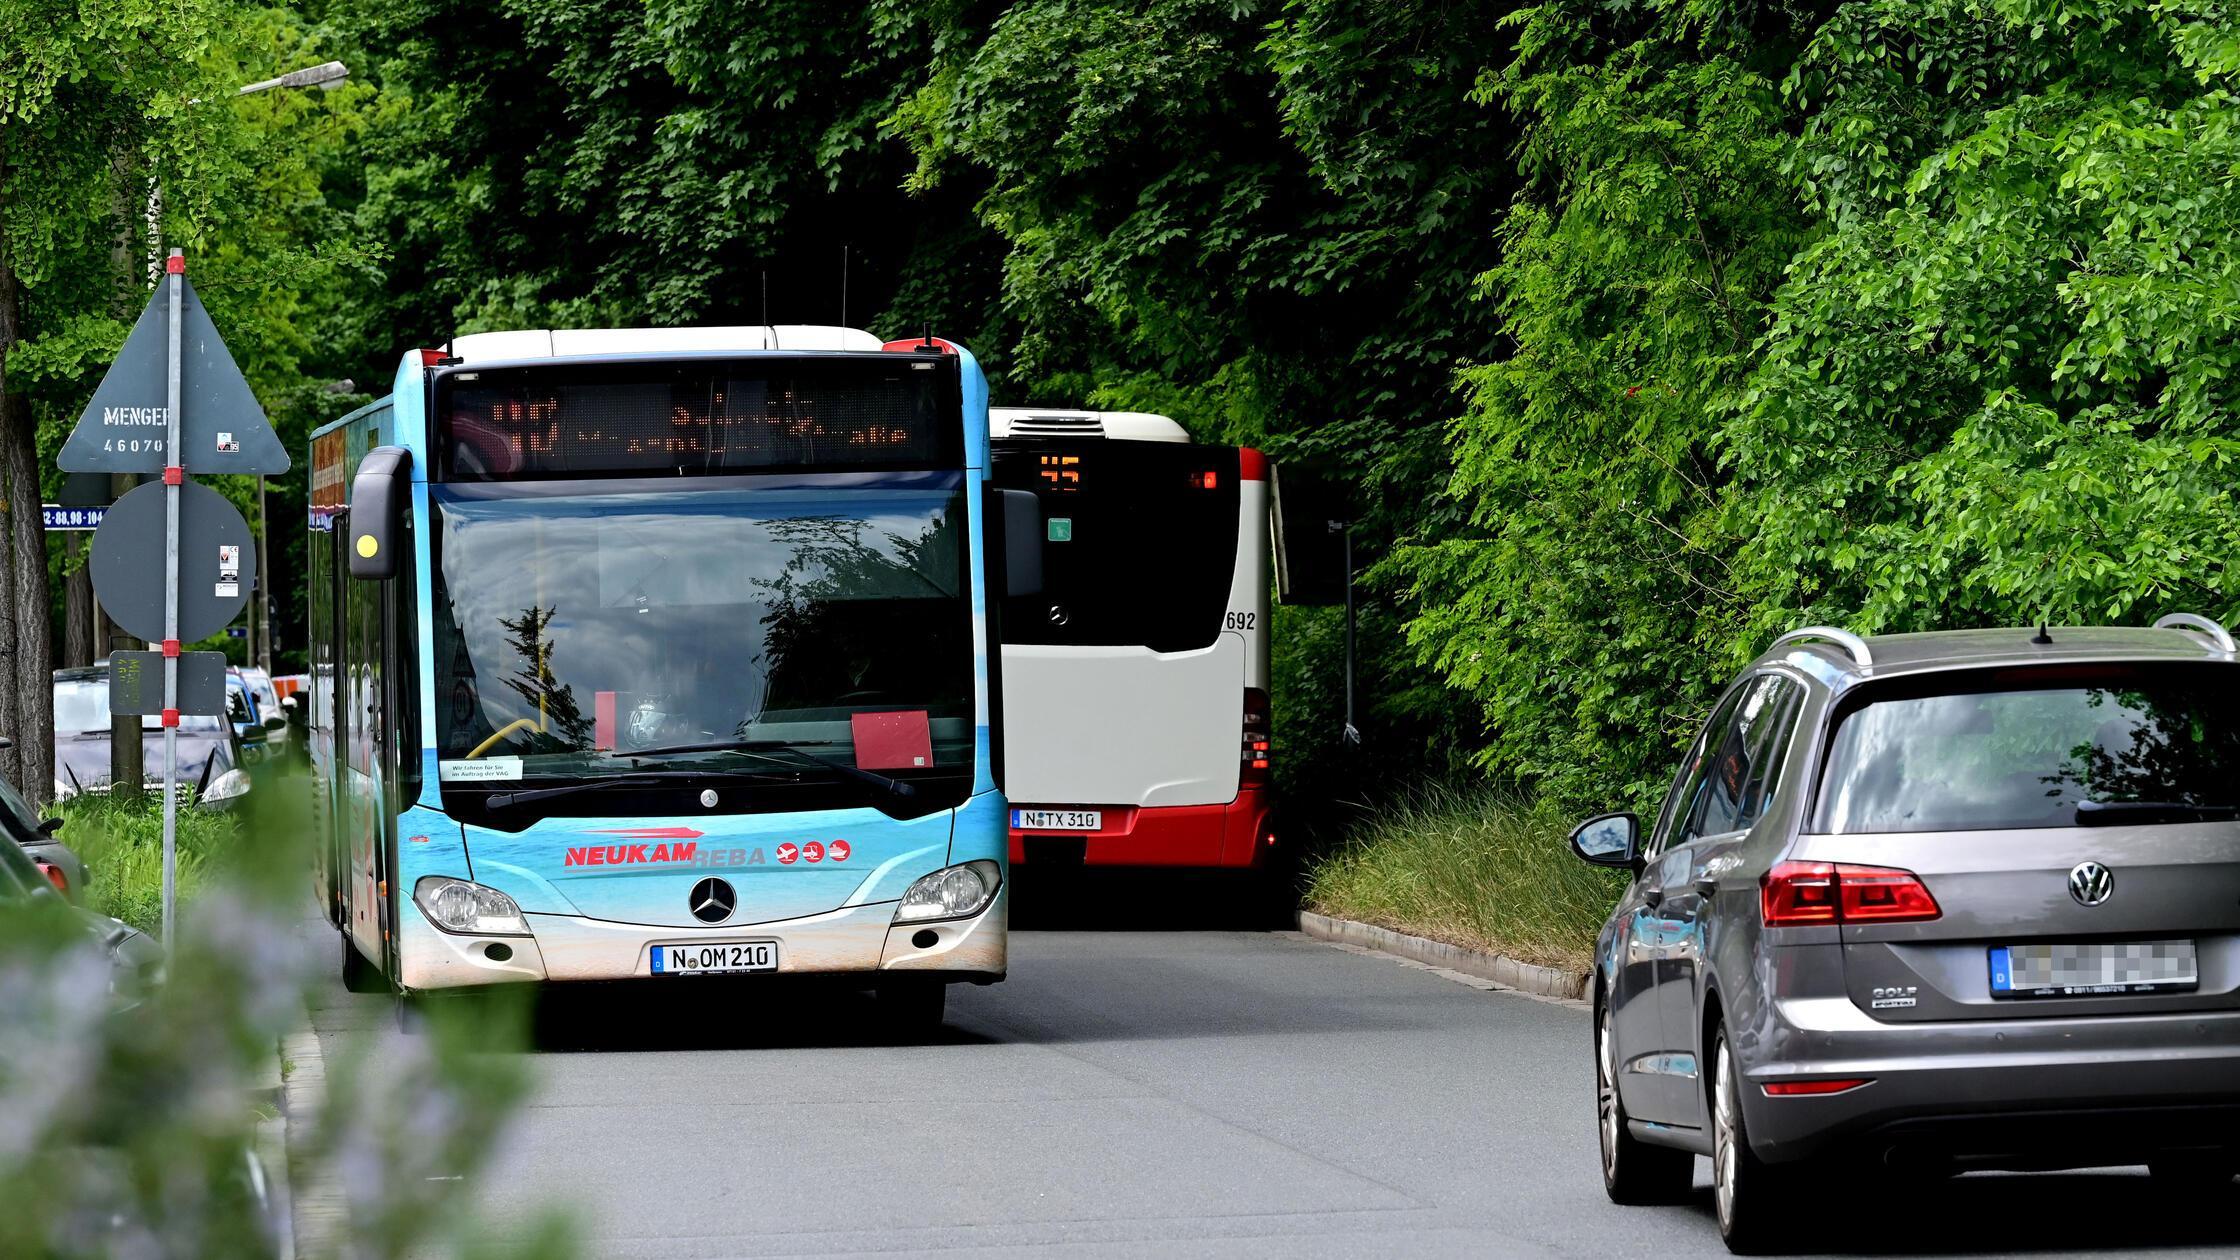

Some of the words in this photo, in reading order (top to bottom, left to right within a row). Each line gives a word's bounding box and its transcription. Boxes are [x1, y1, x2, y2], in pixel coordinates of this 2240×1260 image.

[104, 439, 168, 453] 46070
[1041, 456, 1079, 491] 45
[1226, 611, 1256, 630] 692
[1026, 812, 1035, 826] N
[1045, 812, 1063, 827] TX
[1068, 813, 1094, 827] 310
[563, 842, 696, 867] NEUKAM
[693, 847, 766, 868] REBA
[672, 949, 686, 969] N
[700, 947, 726, 968] OM
[731, 946, 768, 967] 210
[1996, 973, 2005, 983] D
[1872, 986, 1917, 998] GOLF
